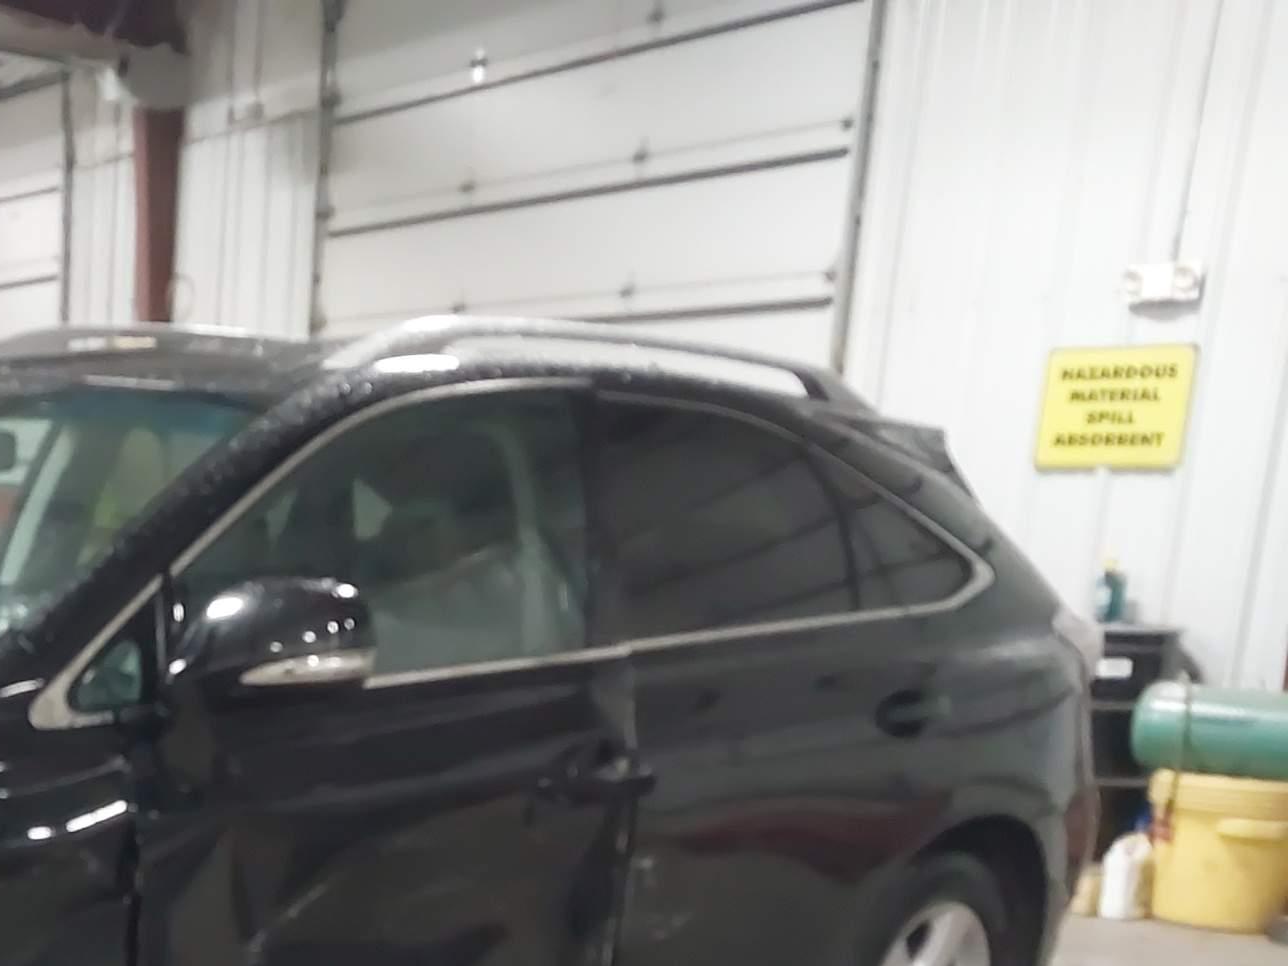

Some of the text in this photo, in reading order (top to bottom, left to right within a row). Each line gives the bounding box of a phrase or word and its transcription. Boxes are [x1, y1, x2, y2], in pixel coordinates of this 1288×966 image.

[1061, 365, 1178, 380] HAZARDOUS
[1070, 387, 1160, 402] MATERIAL
[1087, 410, 1134, 424] SPILL
[1054, 432, 1164, 447] ABSORBENT
